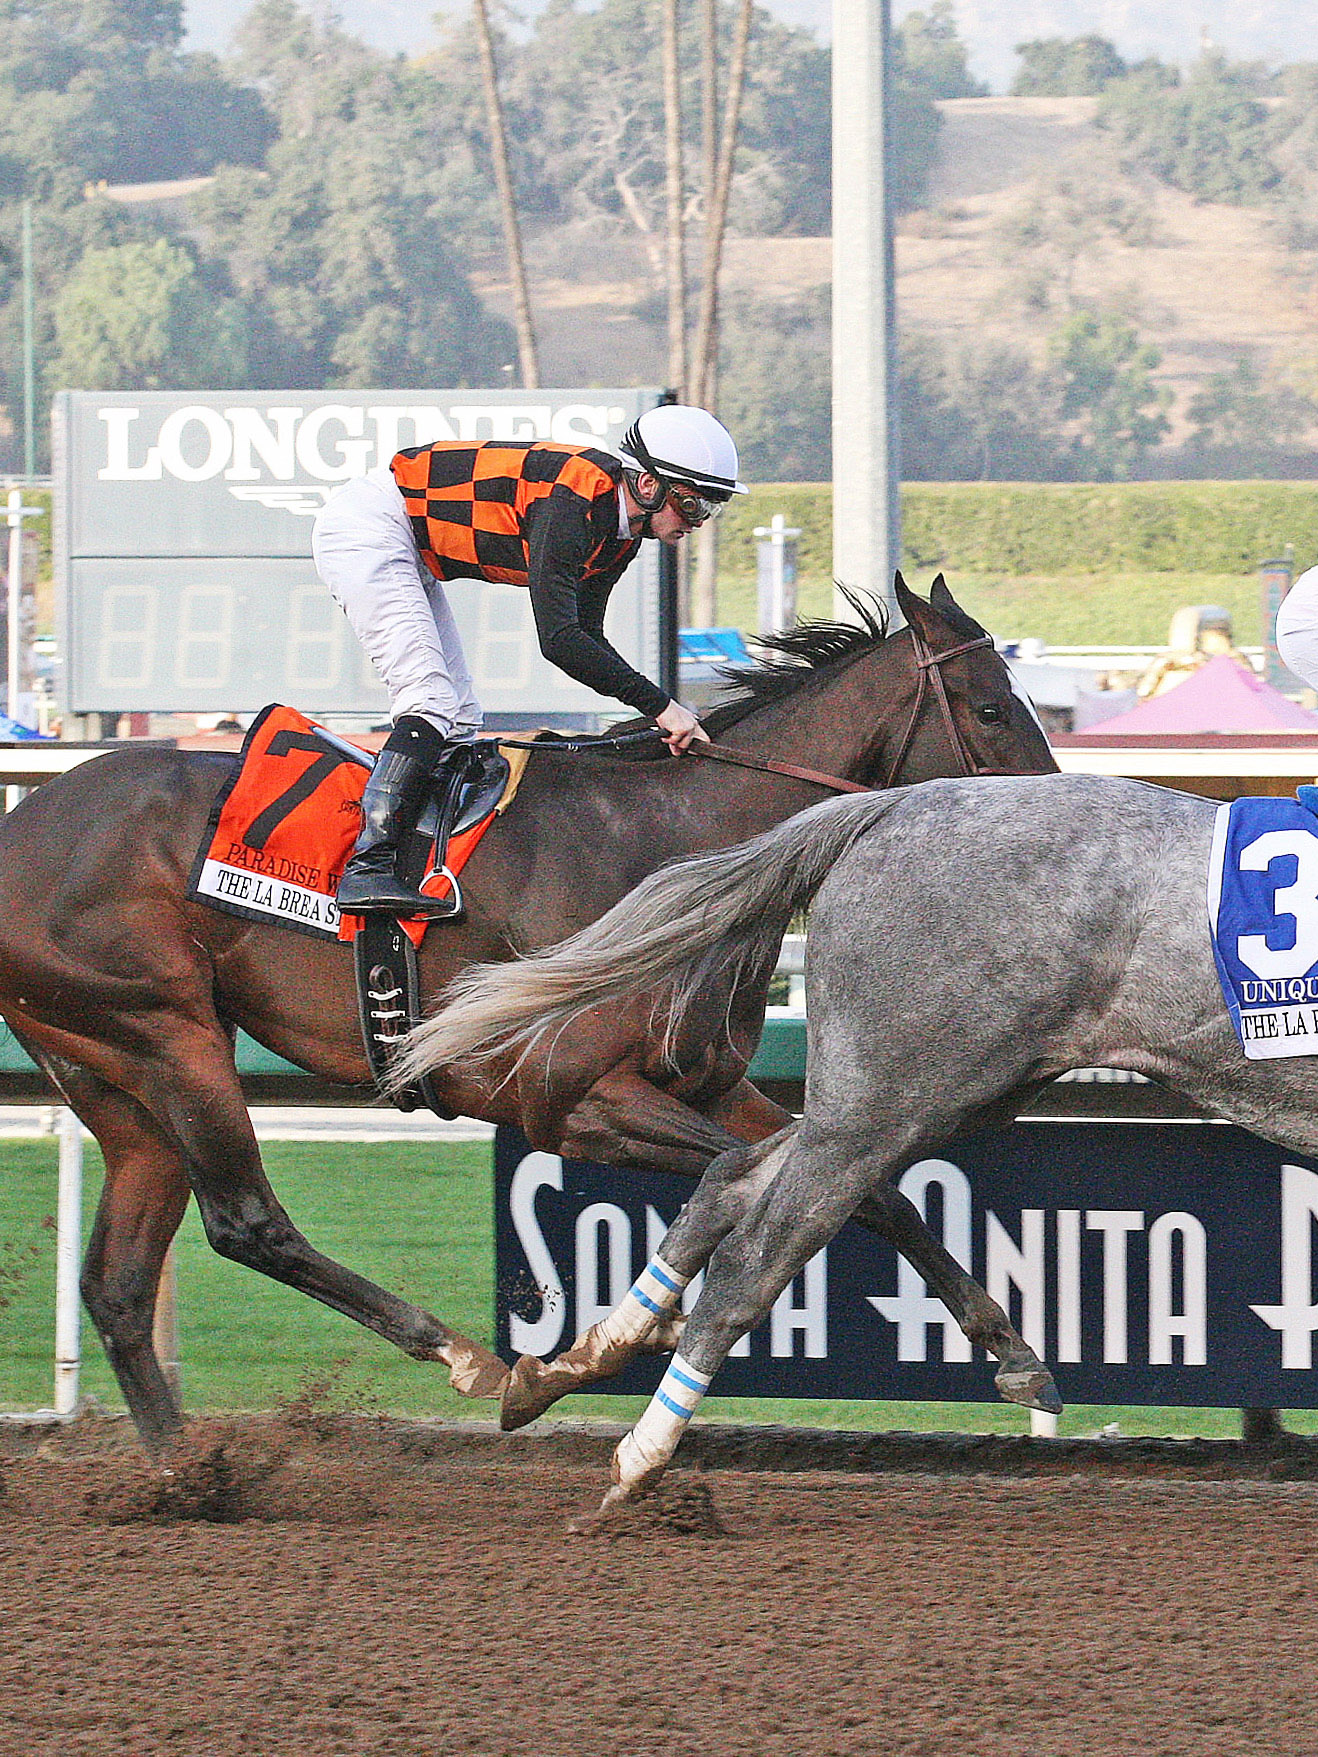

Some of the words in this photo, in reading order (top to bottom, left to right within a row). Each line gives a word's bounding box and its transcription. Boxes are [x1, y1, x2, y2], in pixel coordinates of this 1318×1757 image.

[242, 730, 348, 850] 7
[224, 842, 322, 889] PARADISE
[215, 869, 250, 901] THE
[253, 880, 273, 907] LA
[278, 887, 321, 921] BREA
[1242, 1013, 1279, 1040] THE
[1282, 1008, 1308, 1036] LA
